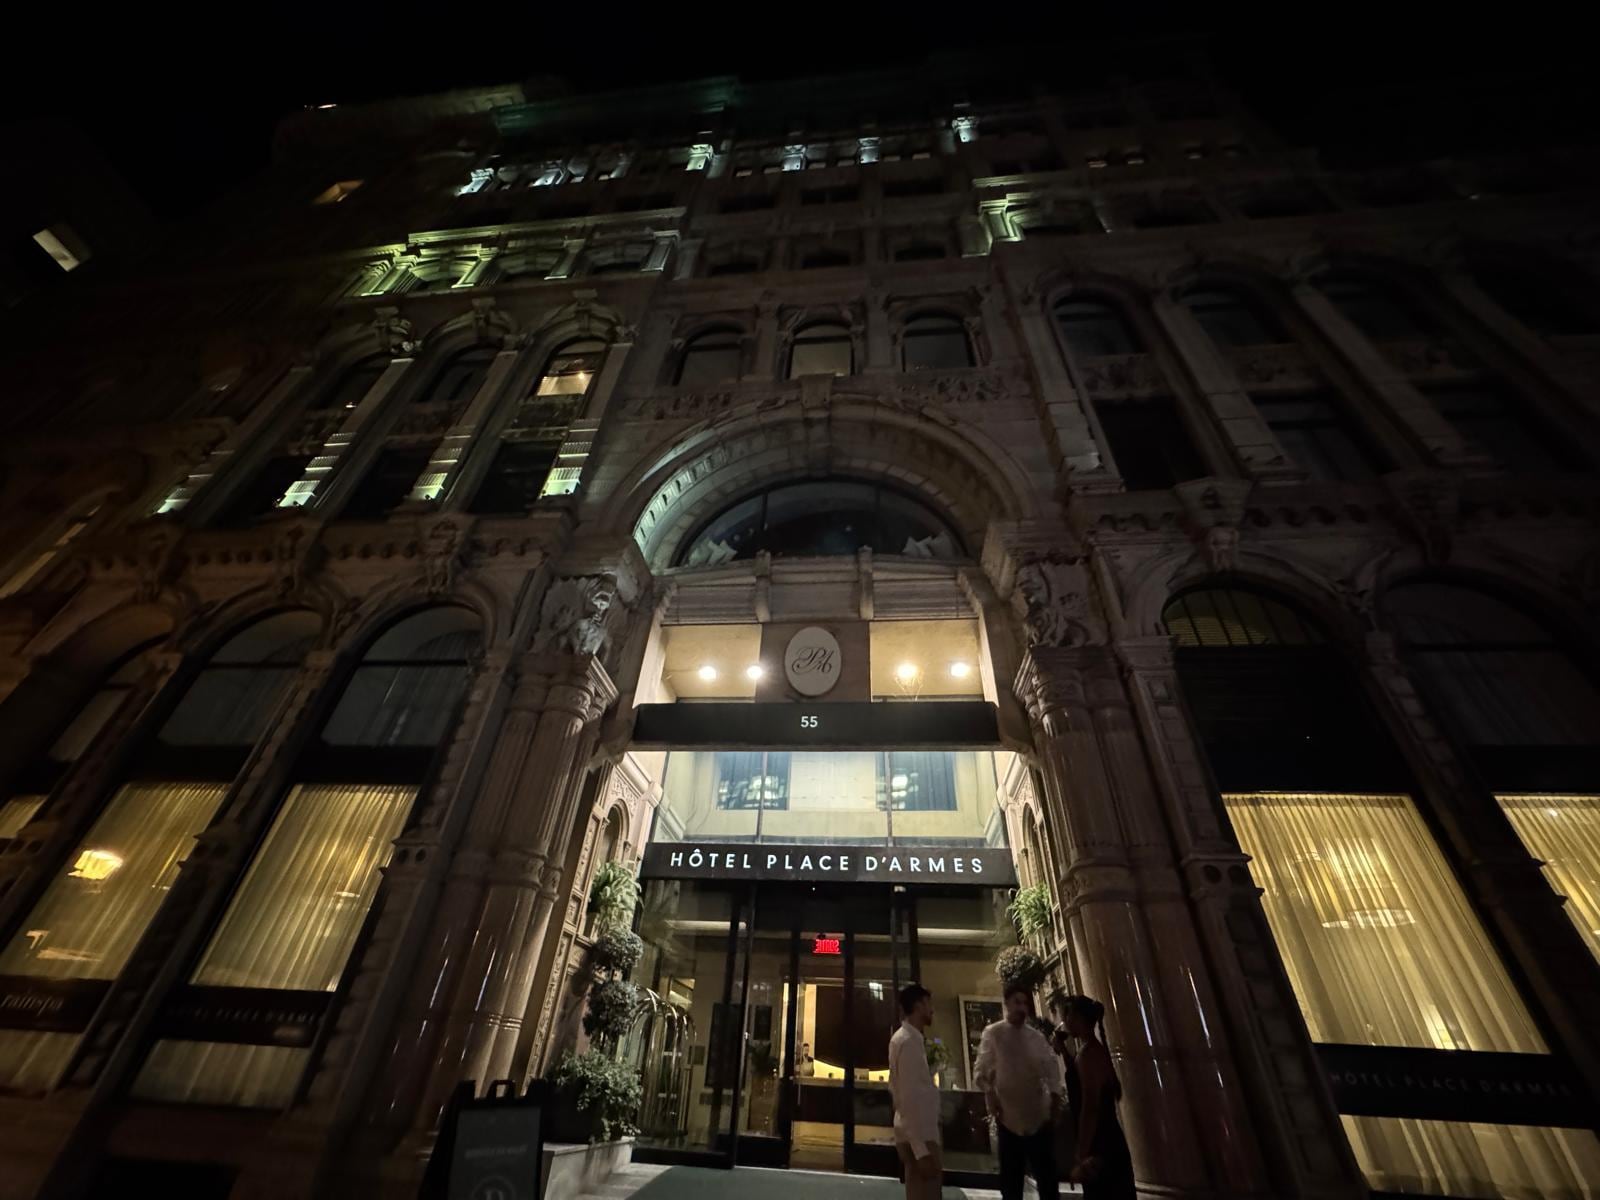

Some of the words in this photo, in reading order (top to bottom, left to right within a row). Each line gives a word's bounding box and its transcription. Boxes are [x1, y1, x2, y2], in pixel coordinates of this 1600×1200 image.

[800, 715, 818, 728] 55
[669, 848, 752, 869] HÔTEL
[766, 853, 849, 872] PLACE
[865, 855, 984, 874] D'ARMES
